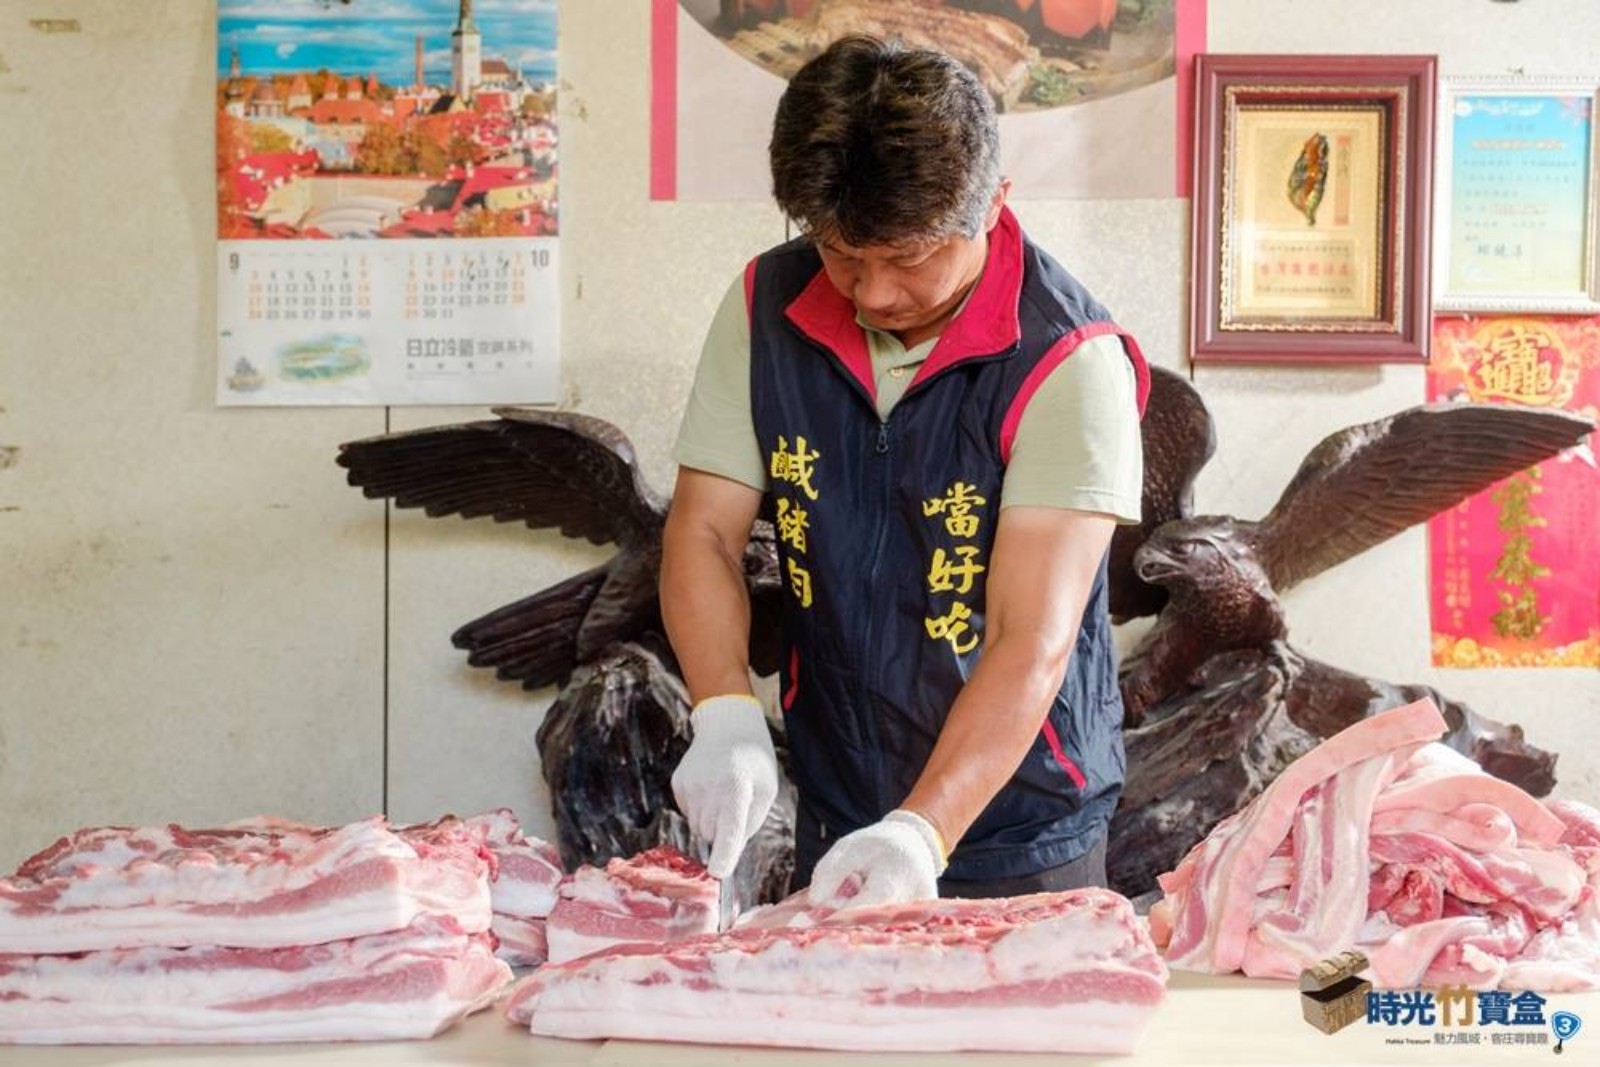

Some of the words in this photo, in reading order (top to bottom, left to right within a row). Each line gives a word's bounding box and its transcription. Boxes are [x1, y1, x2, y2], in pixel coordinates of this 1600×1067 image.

[229, 252, 240, 270] 9
[531, 249, 550, 267] 10
[771, 435, 820, 608] 鹹豬肉
[922, 482, 986, 655] 噹好吃
